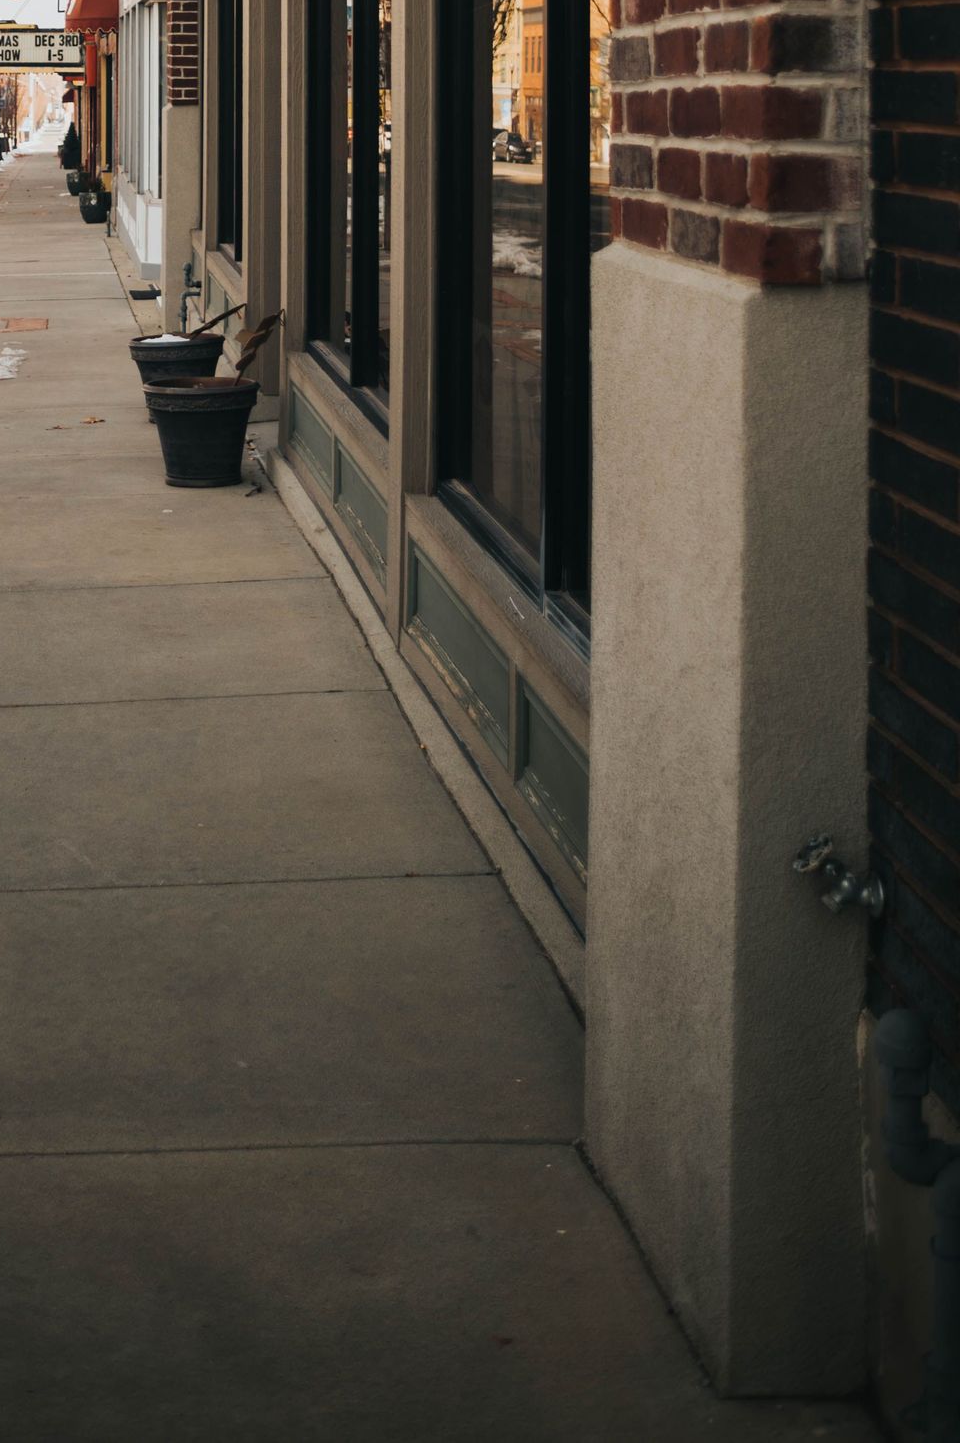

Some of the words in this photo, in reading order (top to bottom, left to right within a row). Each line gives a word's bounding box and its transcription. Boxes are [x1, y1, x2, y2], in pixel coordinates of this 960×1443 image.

[35, 35, 55, 47] DEC
[59, 35, 79, 47] 3RD
[47, 50, 64, 61] 1-5
